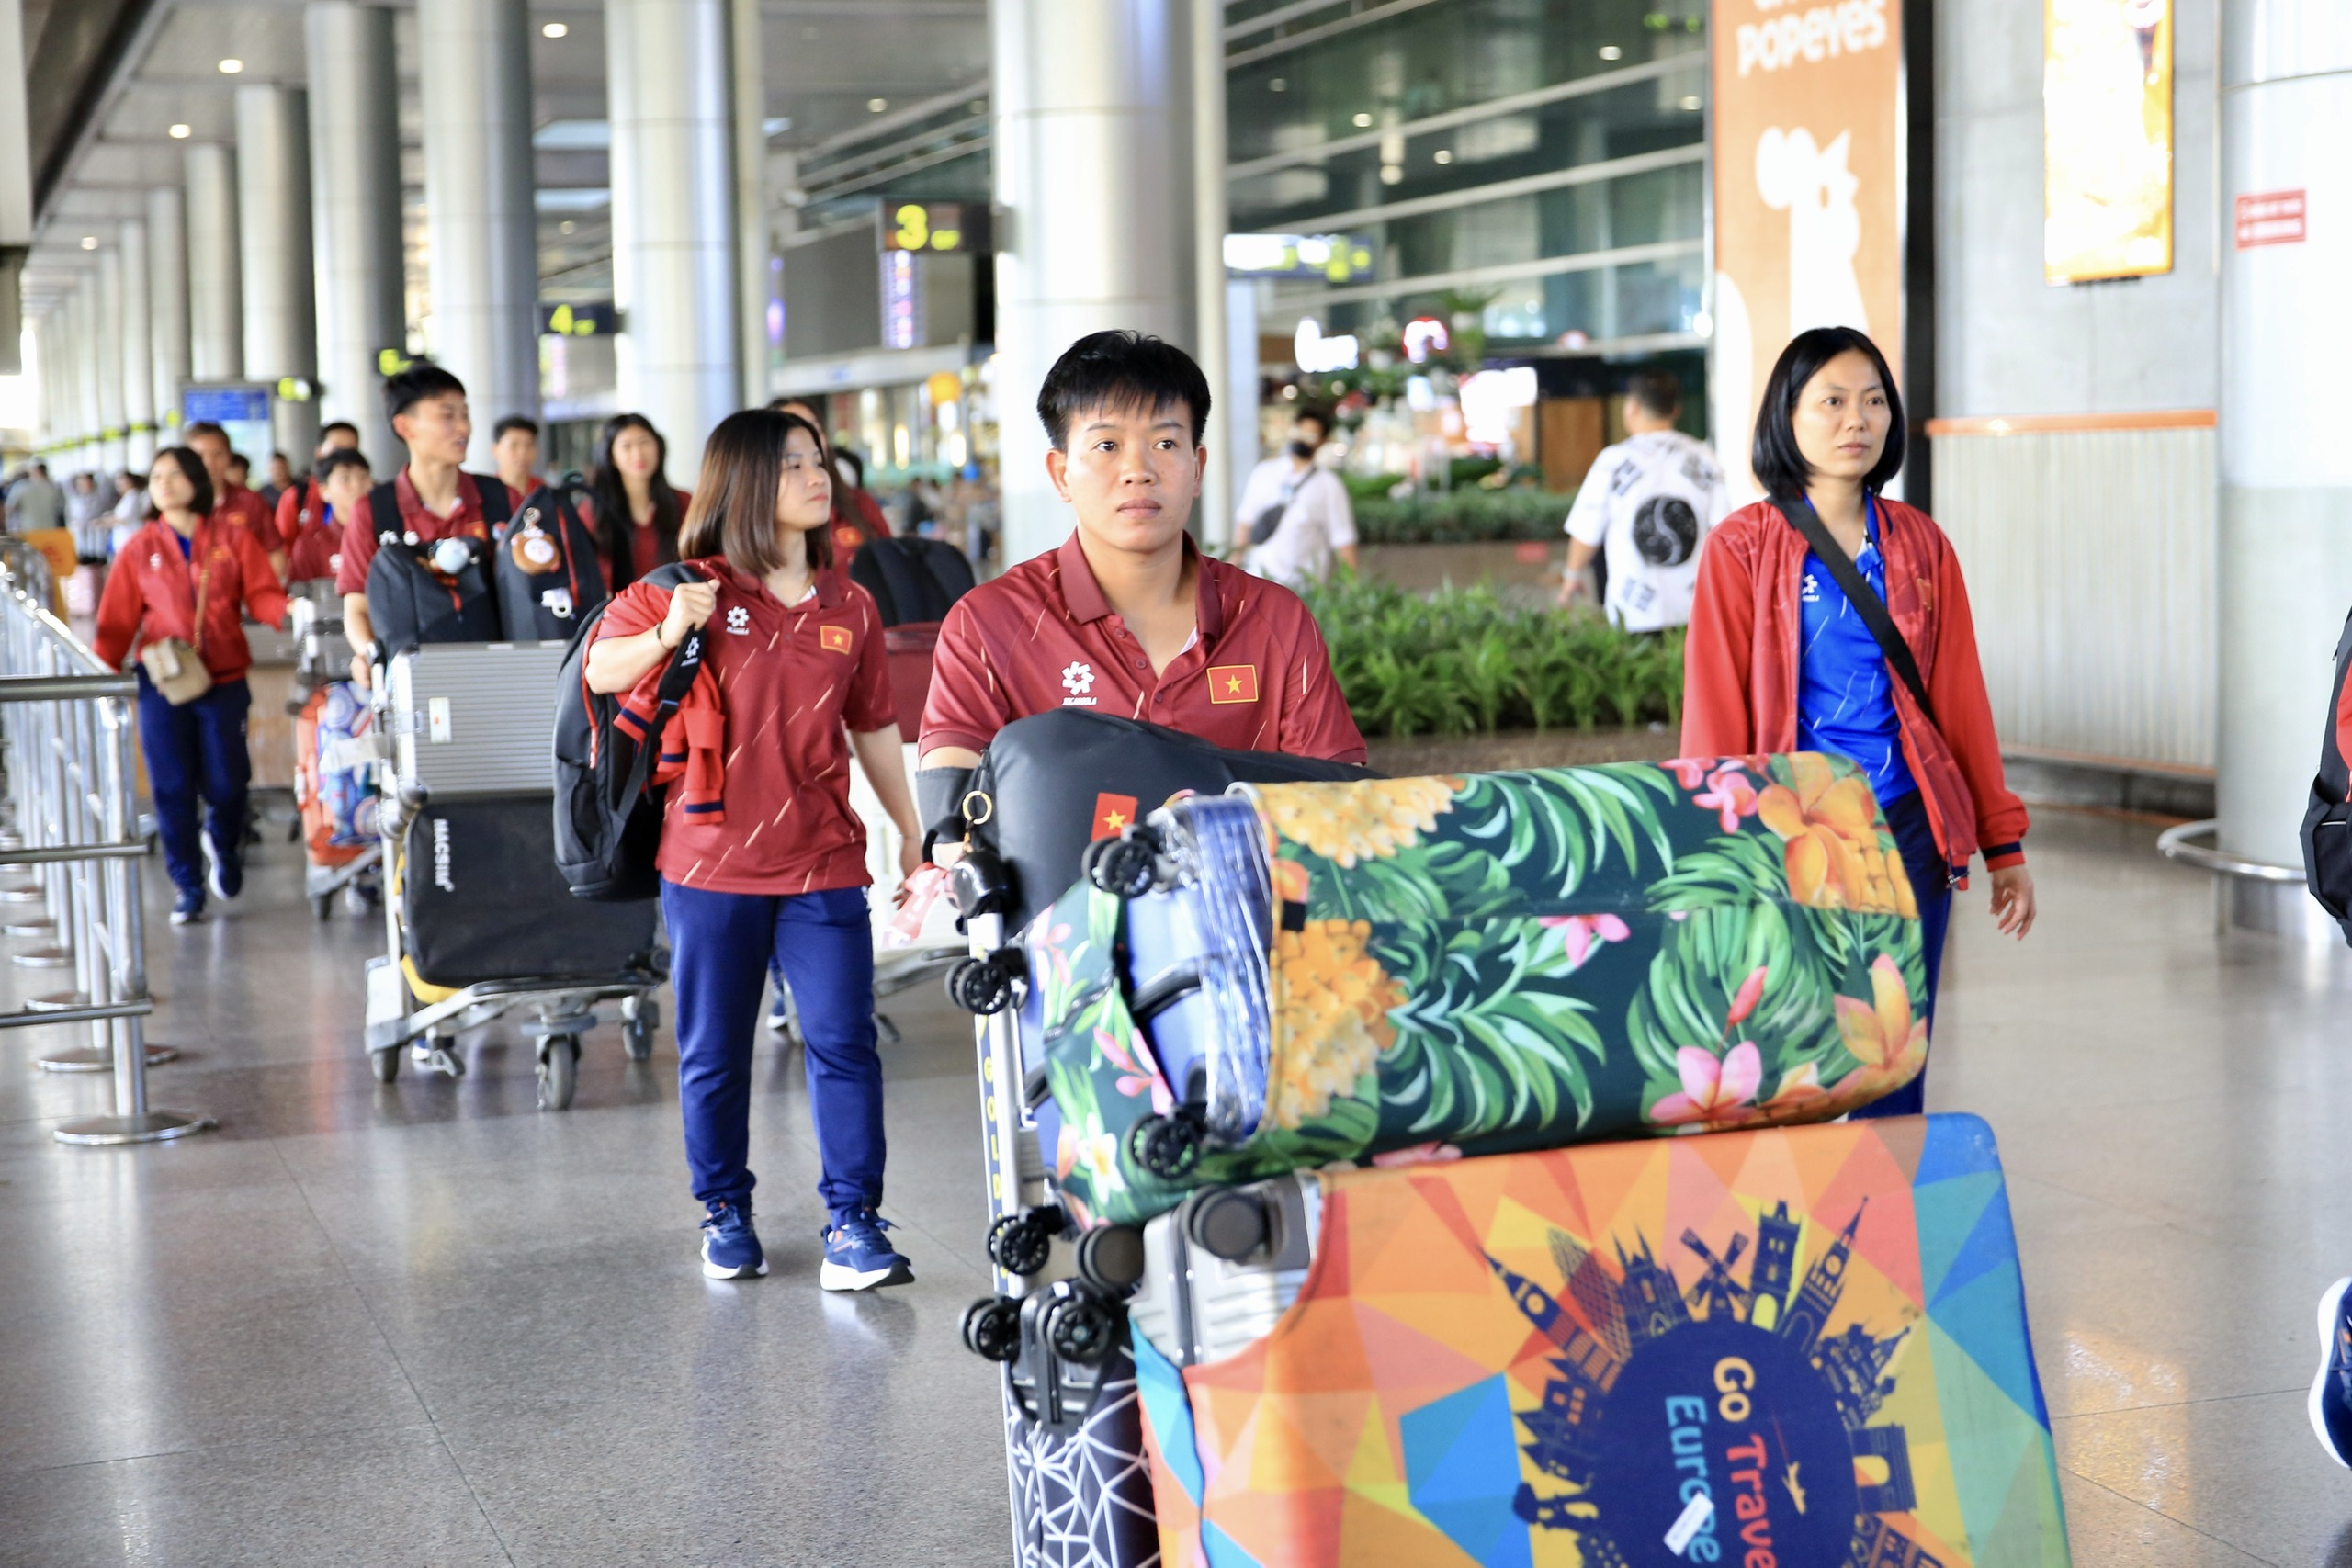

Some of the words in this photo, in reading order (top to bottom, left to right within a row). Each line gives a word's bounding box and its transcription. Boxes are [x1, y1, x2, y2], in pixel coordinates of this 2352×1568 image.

[895, 204, 928, 251] 3
[549, 303, 572, 336] 4
[1713, 1356, 1756, 1423] Go
